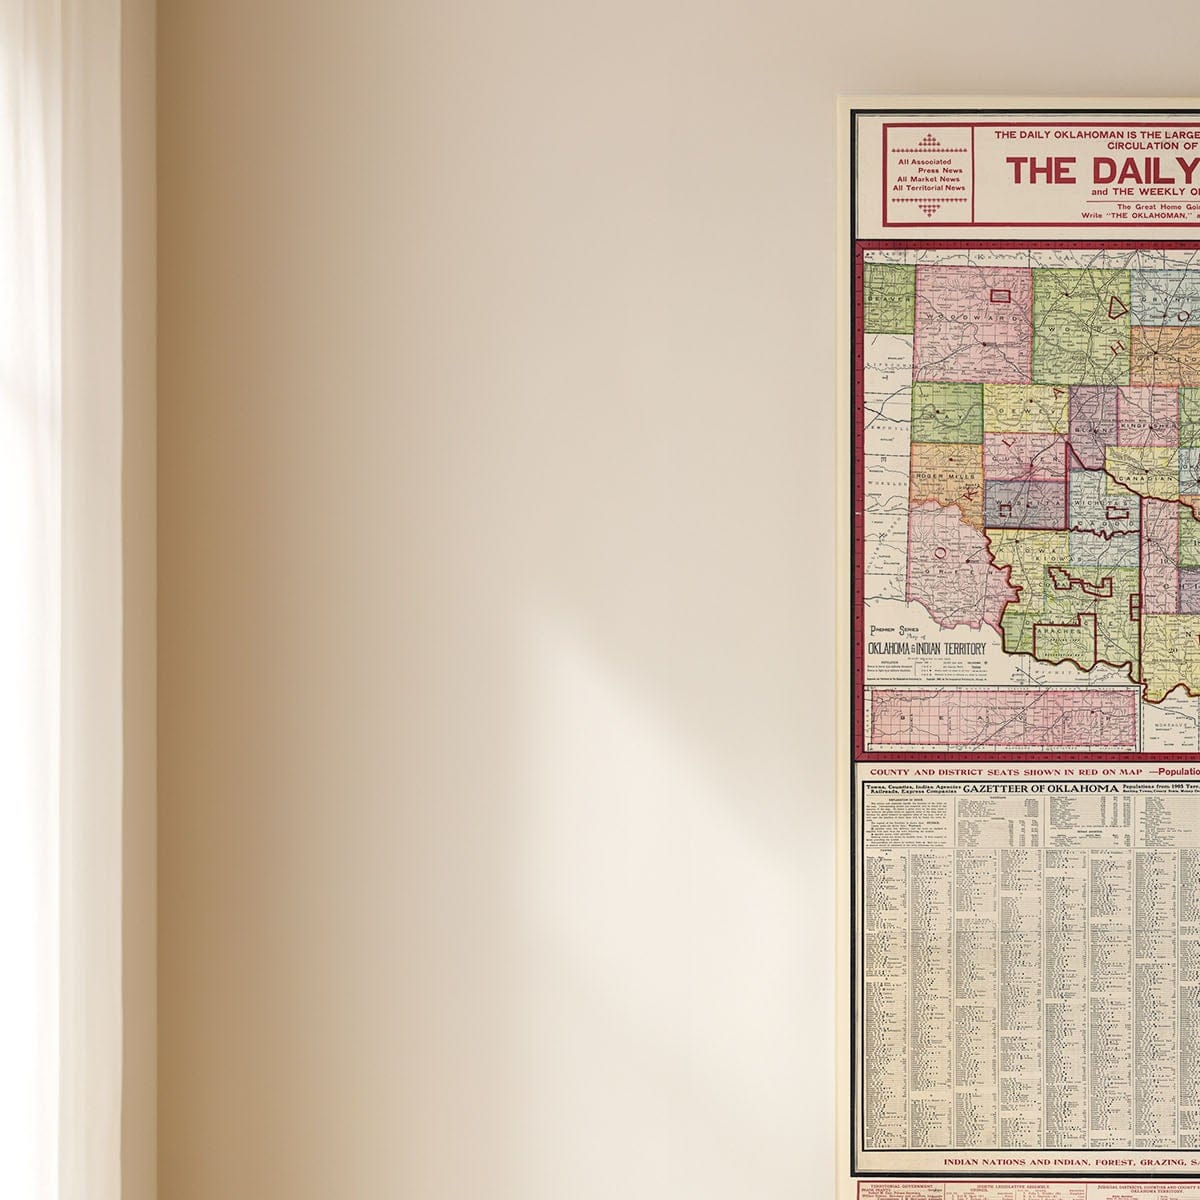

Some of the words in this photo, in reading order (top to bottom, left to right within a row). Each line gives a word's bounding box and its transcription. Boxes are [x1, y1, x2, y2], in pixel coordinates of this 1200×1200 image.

[1127, 131, 1137, 139] IS
[1107, 142, 1179, 150] CIRCULATION
[1184, 142, 1198, 150] OF
[1006, 157, 1076, 184] THE
[868, 642, 910, 655] OKLAHOMA
[916, 642, 940, 655] INDIAN
[944, 642, 986, 655] TERRITORY
[963, 785, 1028, 793] GAZETTEER
[1047, 784, 1119, 793] OKLAHOMA
